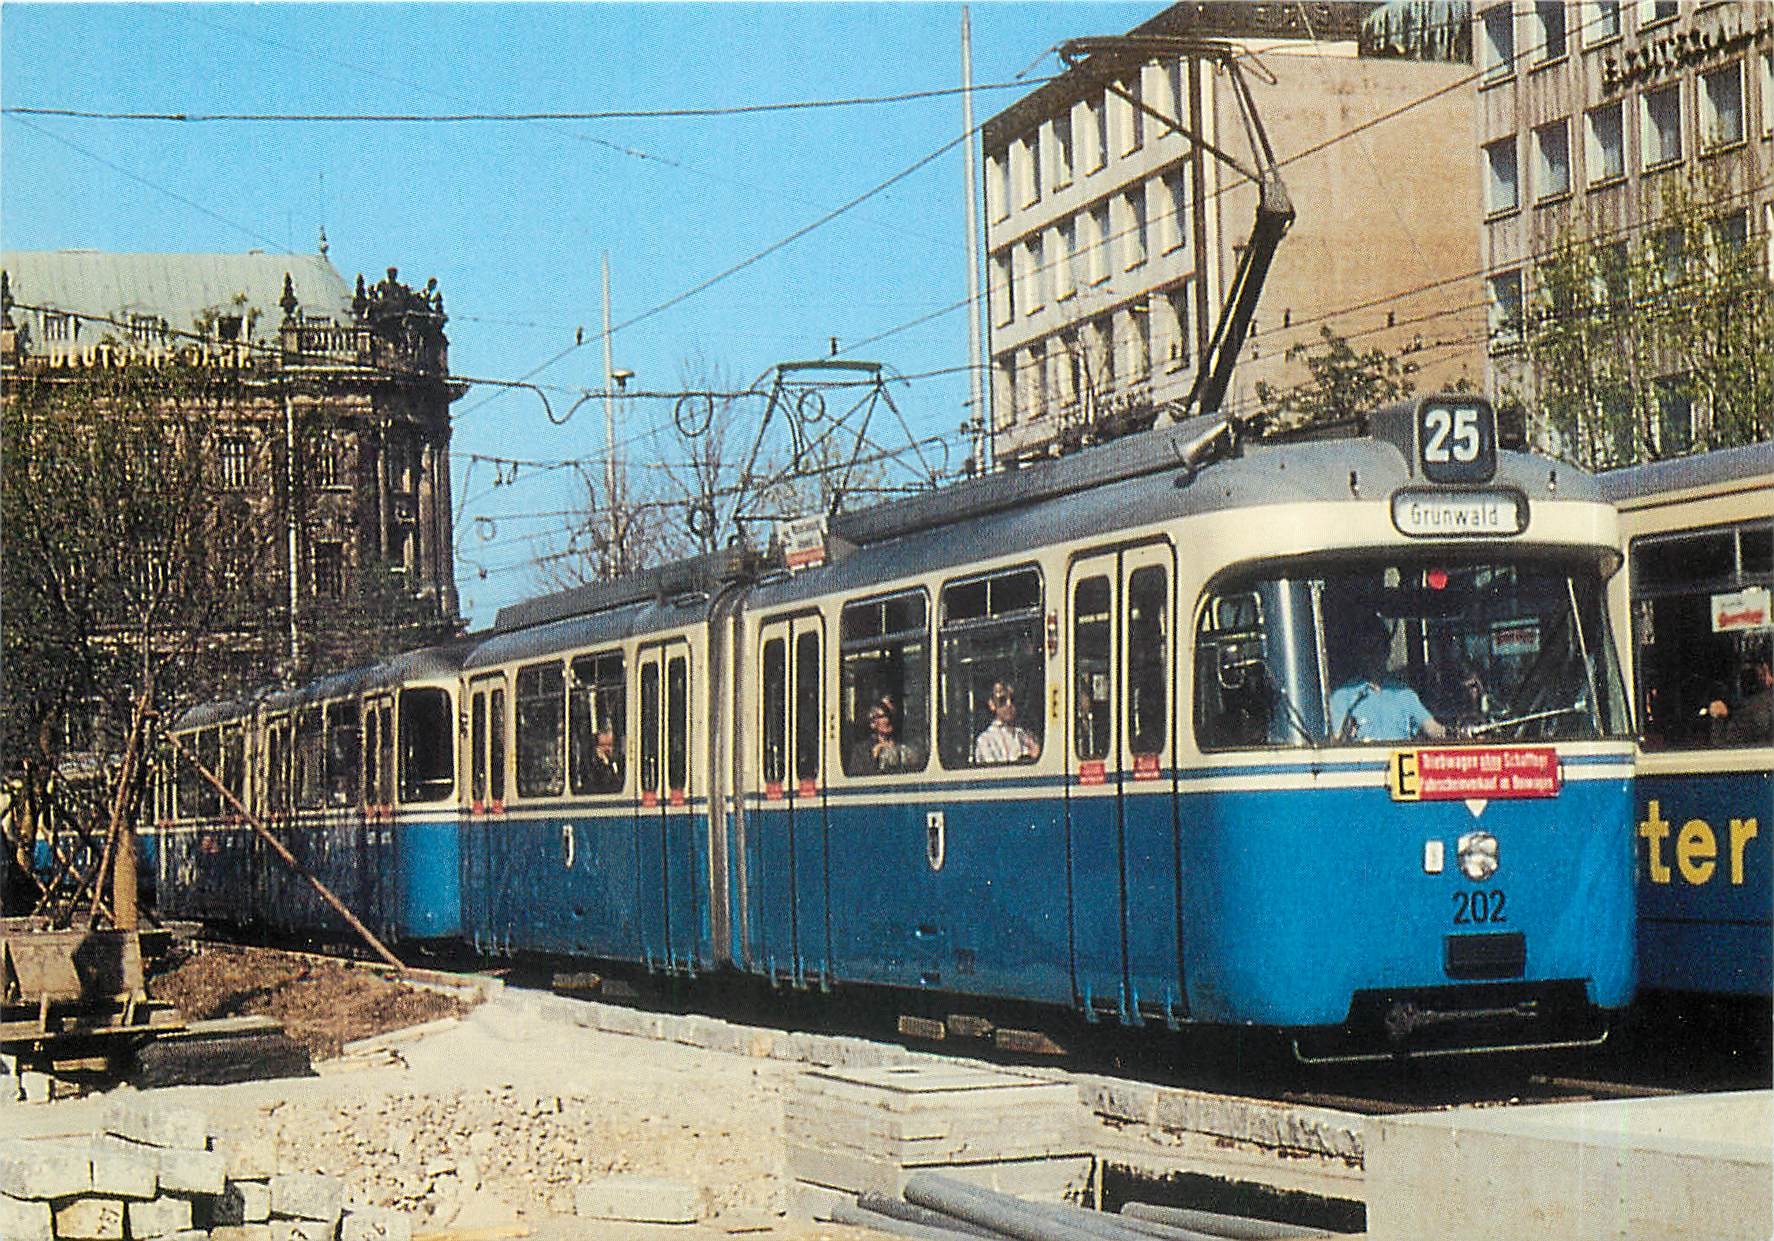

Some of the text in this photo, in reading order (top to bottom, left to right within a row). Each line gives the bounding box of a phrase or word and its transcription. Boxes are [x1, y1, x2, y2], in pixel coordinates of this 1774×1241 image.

[1425, 409, 1480, 462] 25
[1397, 753, 1416, 795] E
[1638, 799, 1758, 886] ter
[1451, 889, 1508, 925] 202
